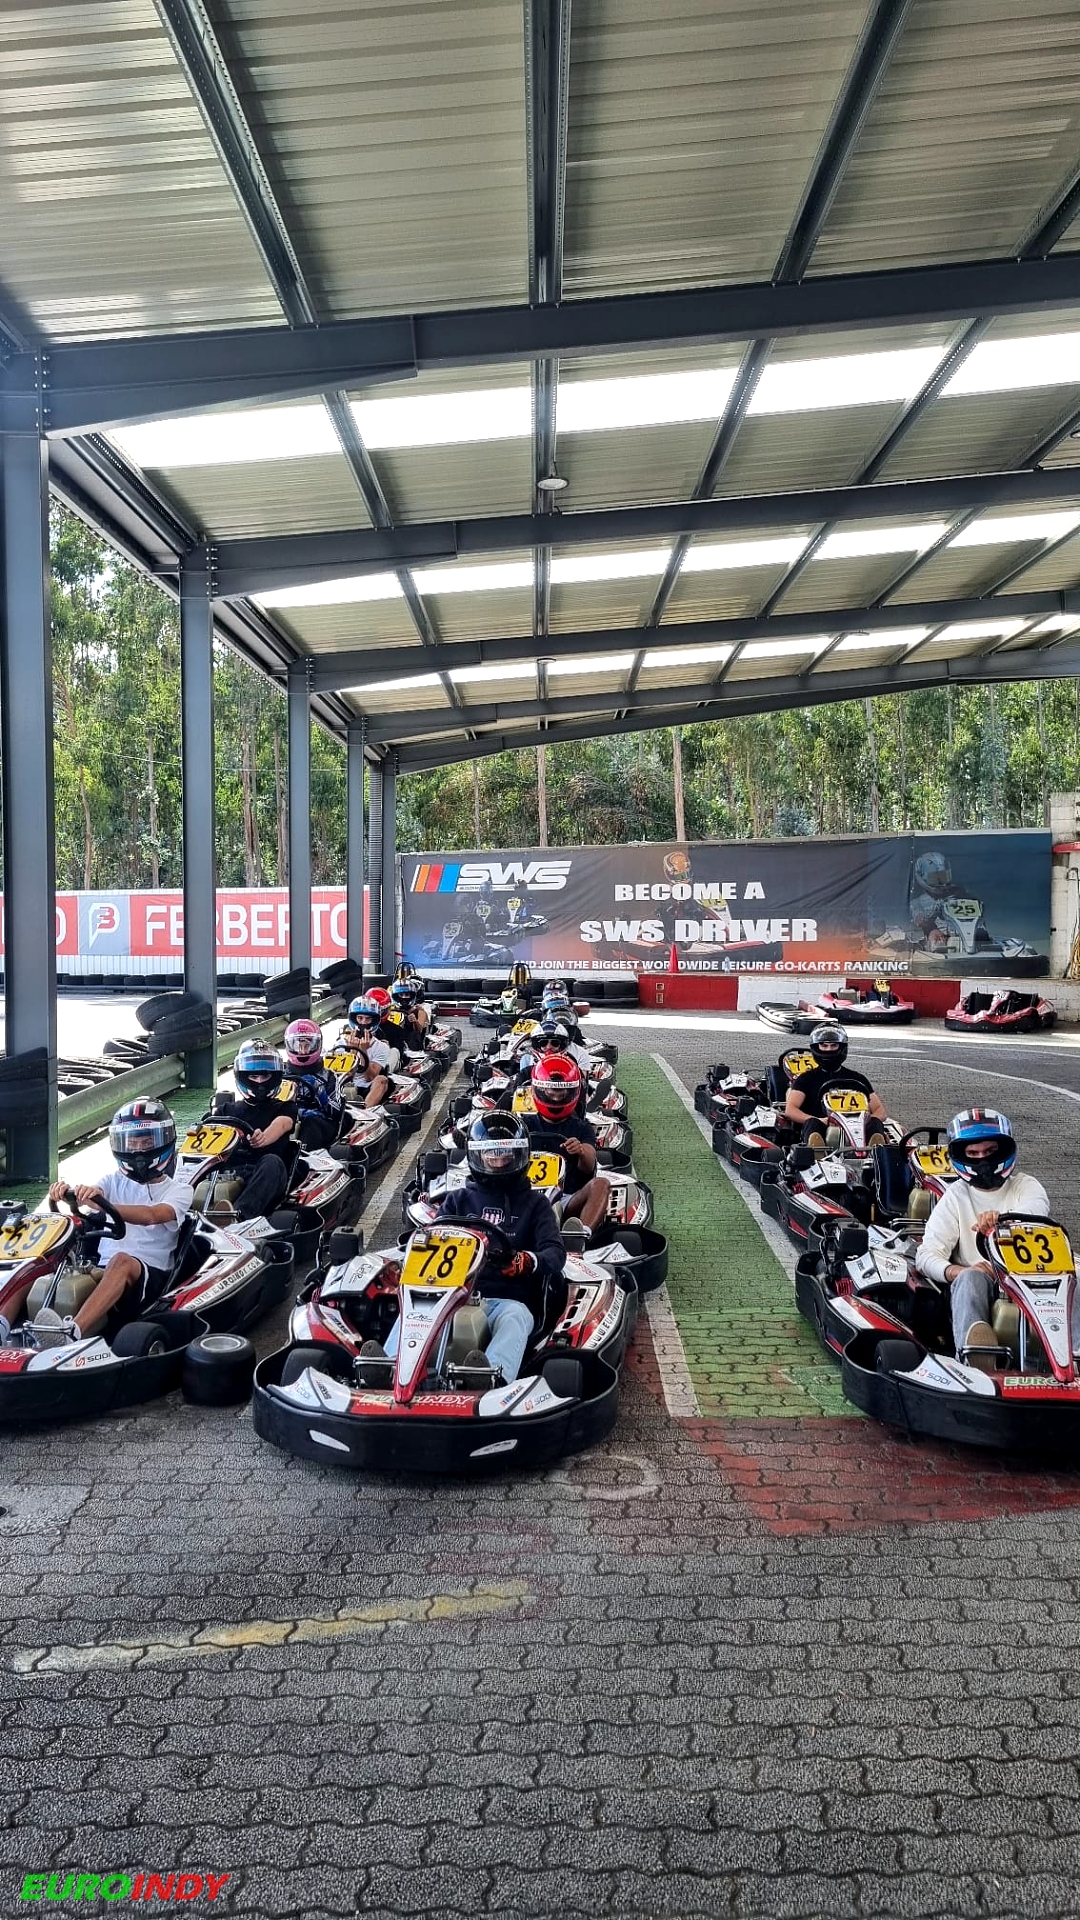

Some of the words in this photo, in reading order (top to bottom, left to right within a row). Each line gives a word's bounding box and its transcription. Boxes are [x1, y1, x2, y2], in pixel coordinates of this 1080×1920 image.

[456, 861, 572, 891] SWS
[614, 883, 737, 901] BECOME
[743, 882, 765, 899] A
[579, 920, 665, 943] SWS
[674, 918, 818, 942] DRIVER
[538, 960, 565, 969] JOIN
[567, 960, 589, 970] THE
[591, 960, 640, 970] BIGGEST
[641, 960, 719, 970] WORDWIDE
[774, 961, 840, 971] GO-KARTS
[843, 961, 909, 971] RANKING
[837, 1095, 860, 1109] 74
[190, 1131, 223, 1150] 87
[4, 1223, 48, 1251] 69
[1012, 1233, 1054, 1265] 63
[418, 1244, 459, 1279] 78
